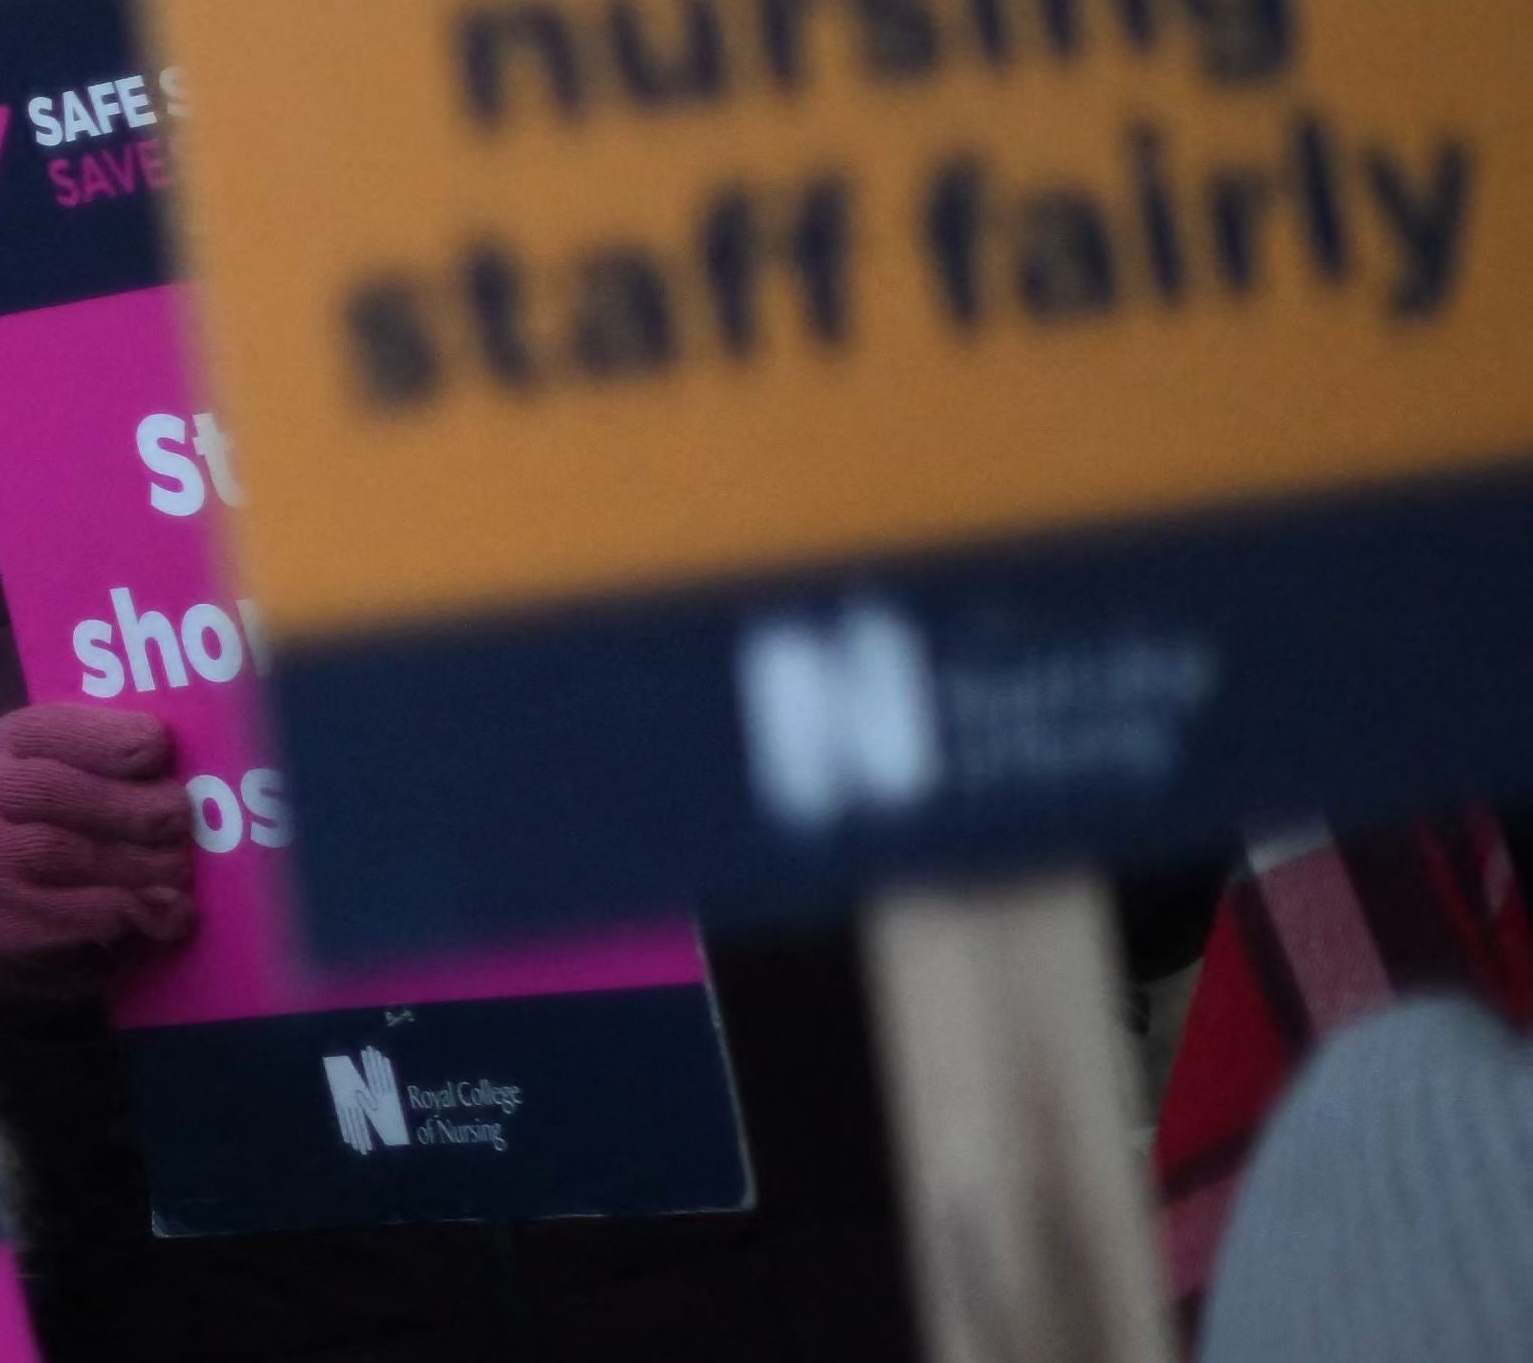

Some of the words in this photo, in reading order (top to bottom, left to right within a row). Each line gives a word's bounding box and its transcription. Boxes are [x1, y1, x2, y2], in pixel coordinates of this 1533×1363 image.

[28, 74, 157, 147] SAFE
[47, 136, 176, 209] SAVE
[339, 157, 855, 419] staff
[921, 107, 1477, 335] fairly
[407, 1080, 456, 1112] Royal
[457, 1079, 523, 1114] College
[417, 1117, 437, 1145] of
[436, 1118, 508, 1151] Nursing
